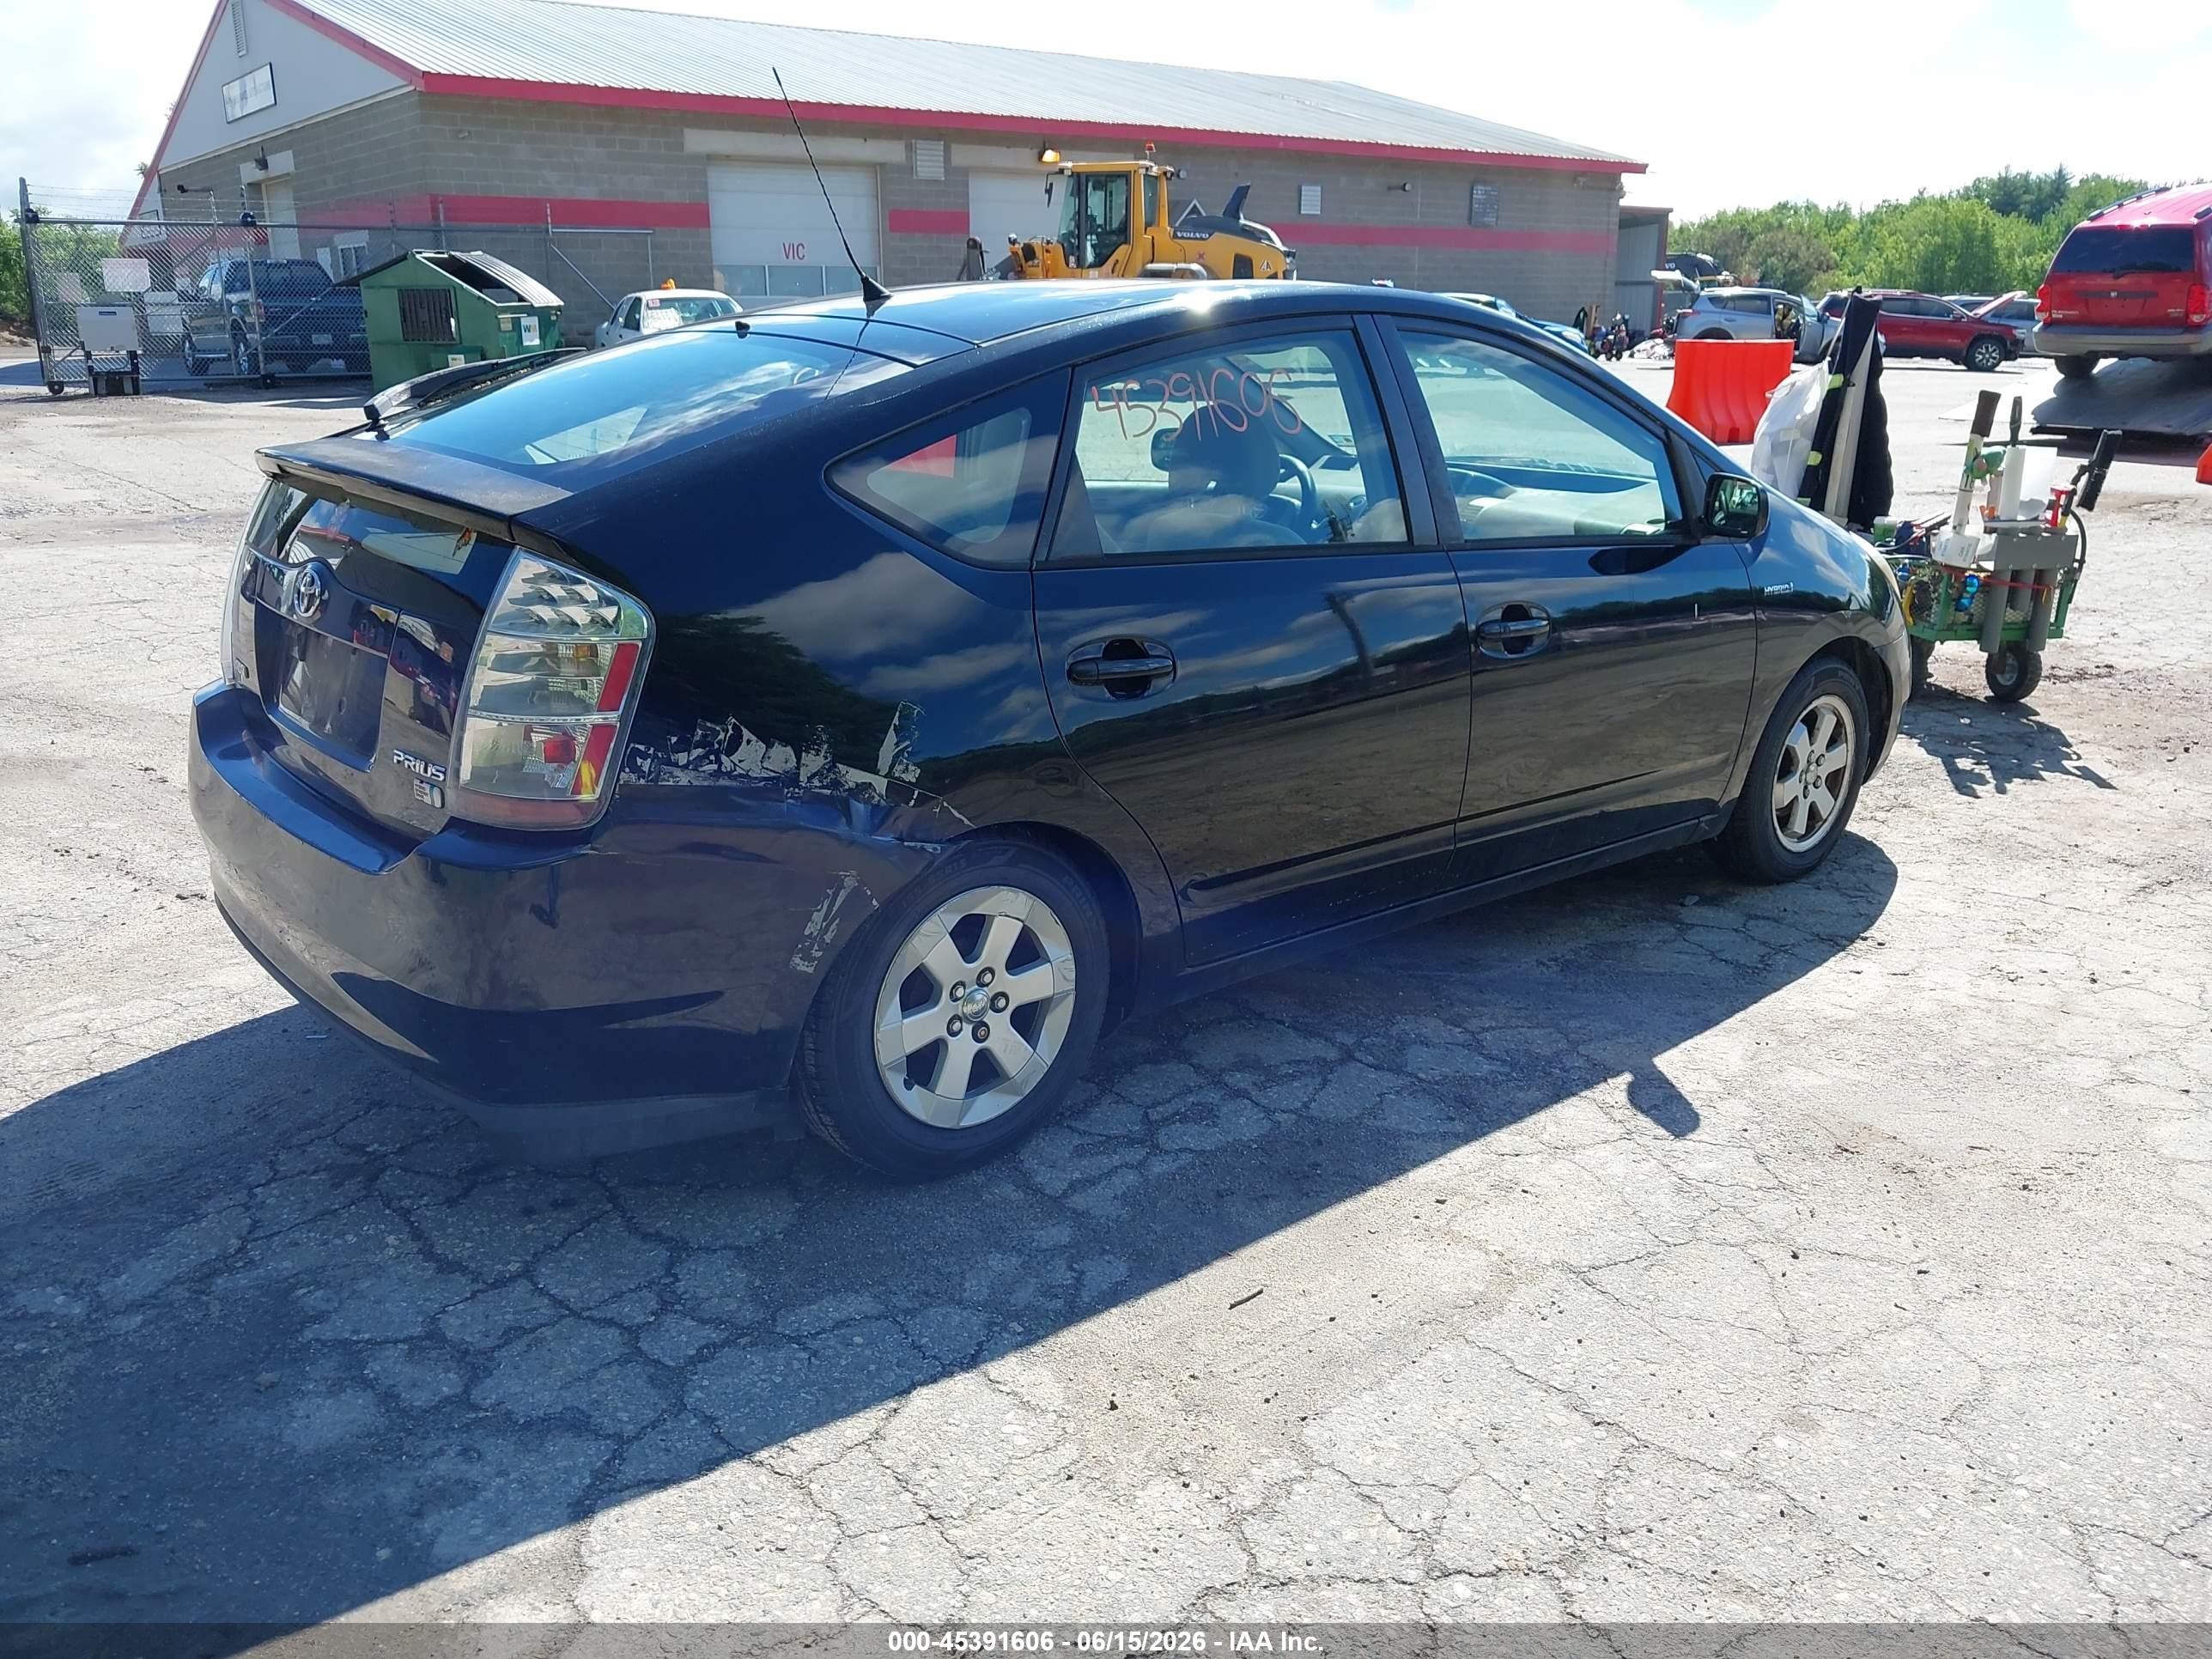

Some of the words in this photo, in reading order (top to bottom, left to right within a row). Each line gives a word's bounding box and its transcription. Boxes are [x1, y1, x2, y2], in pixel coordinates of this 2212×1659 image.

[782, 242, 805, 260] VIC
[1091, 368, 1302, 441] 45391606
[392, 749, 447, 781] PRIUS
